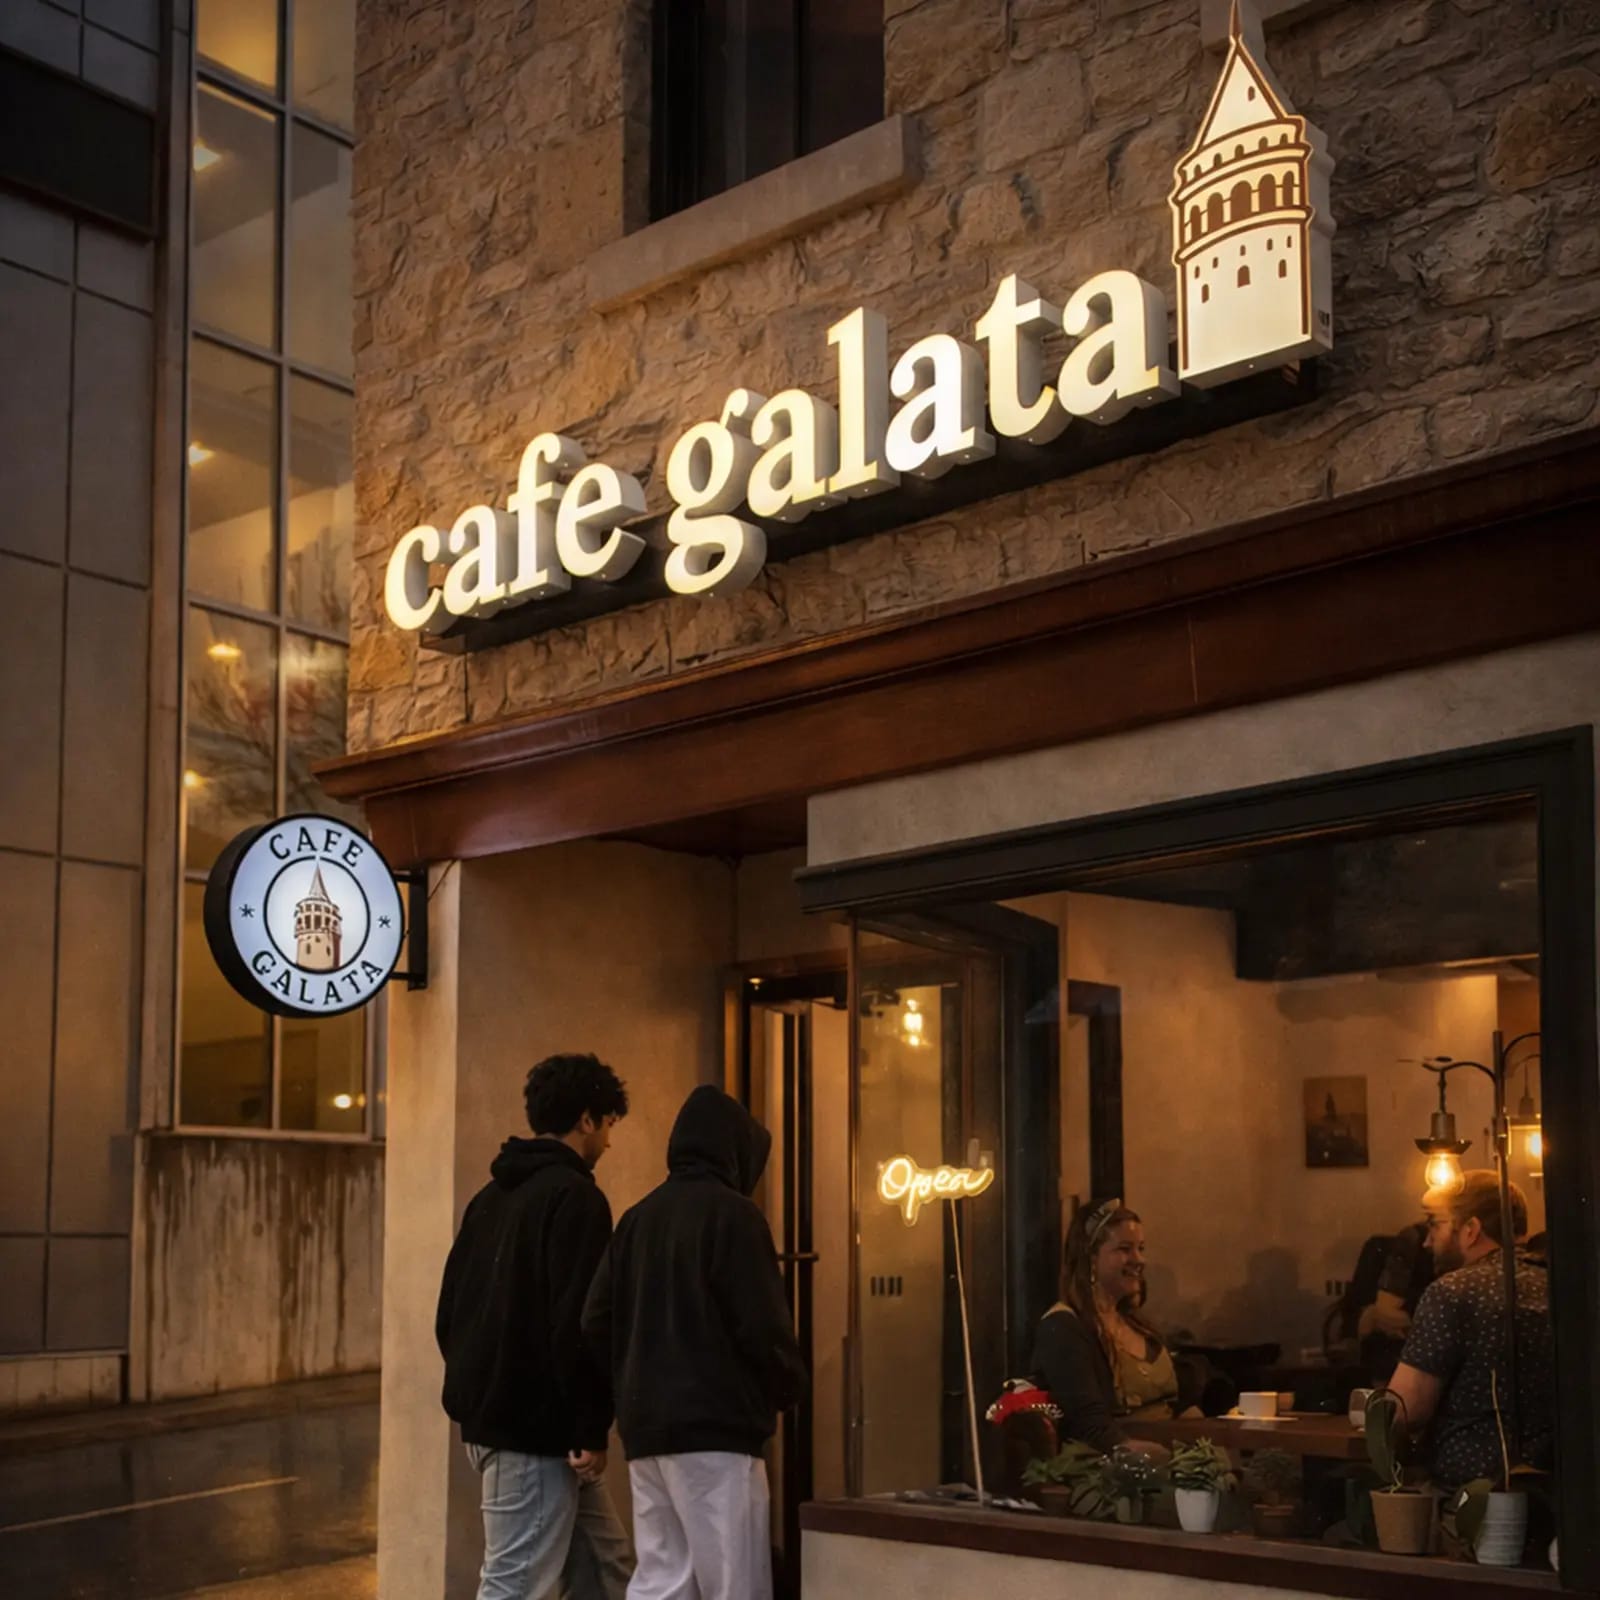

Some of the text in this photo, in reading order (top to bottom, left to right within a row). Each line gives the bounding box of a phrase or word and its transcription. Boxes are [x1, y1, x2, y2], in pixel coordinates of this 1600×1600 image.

[384, 269, 1160, 632] cafe galata
[269, 826, 364, 868] CAFE
[252, 950, 383, 1006] GALATA
[880, 1157, 993, 1220] Open
